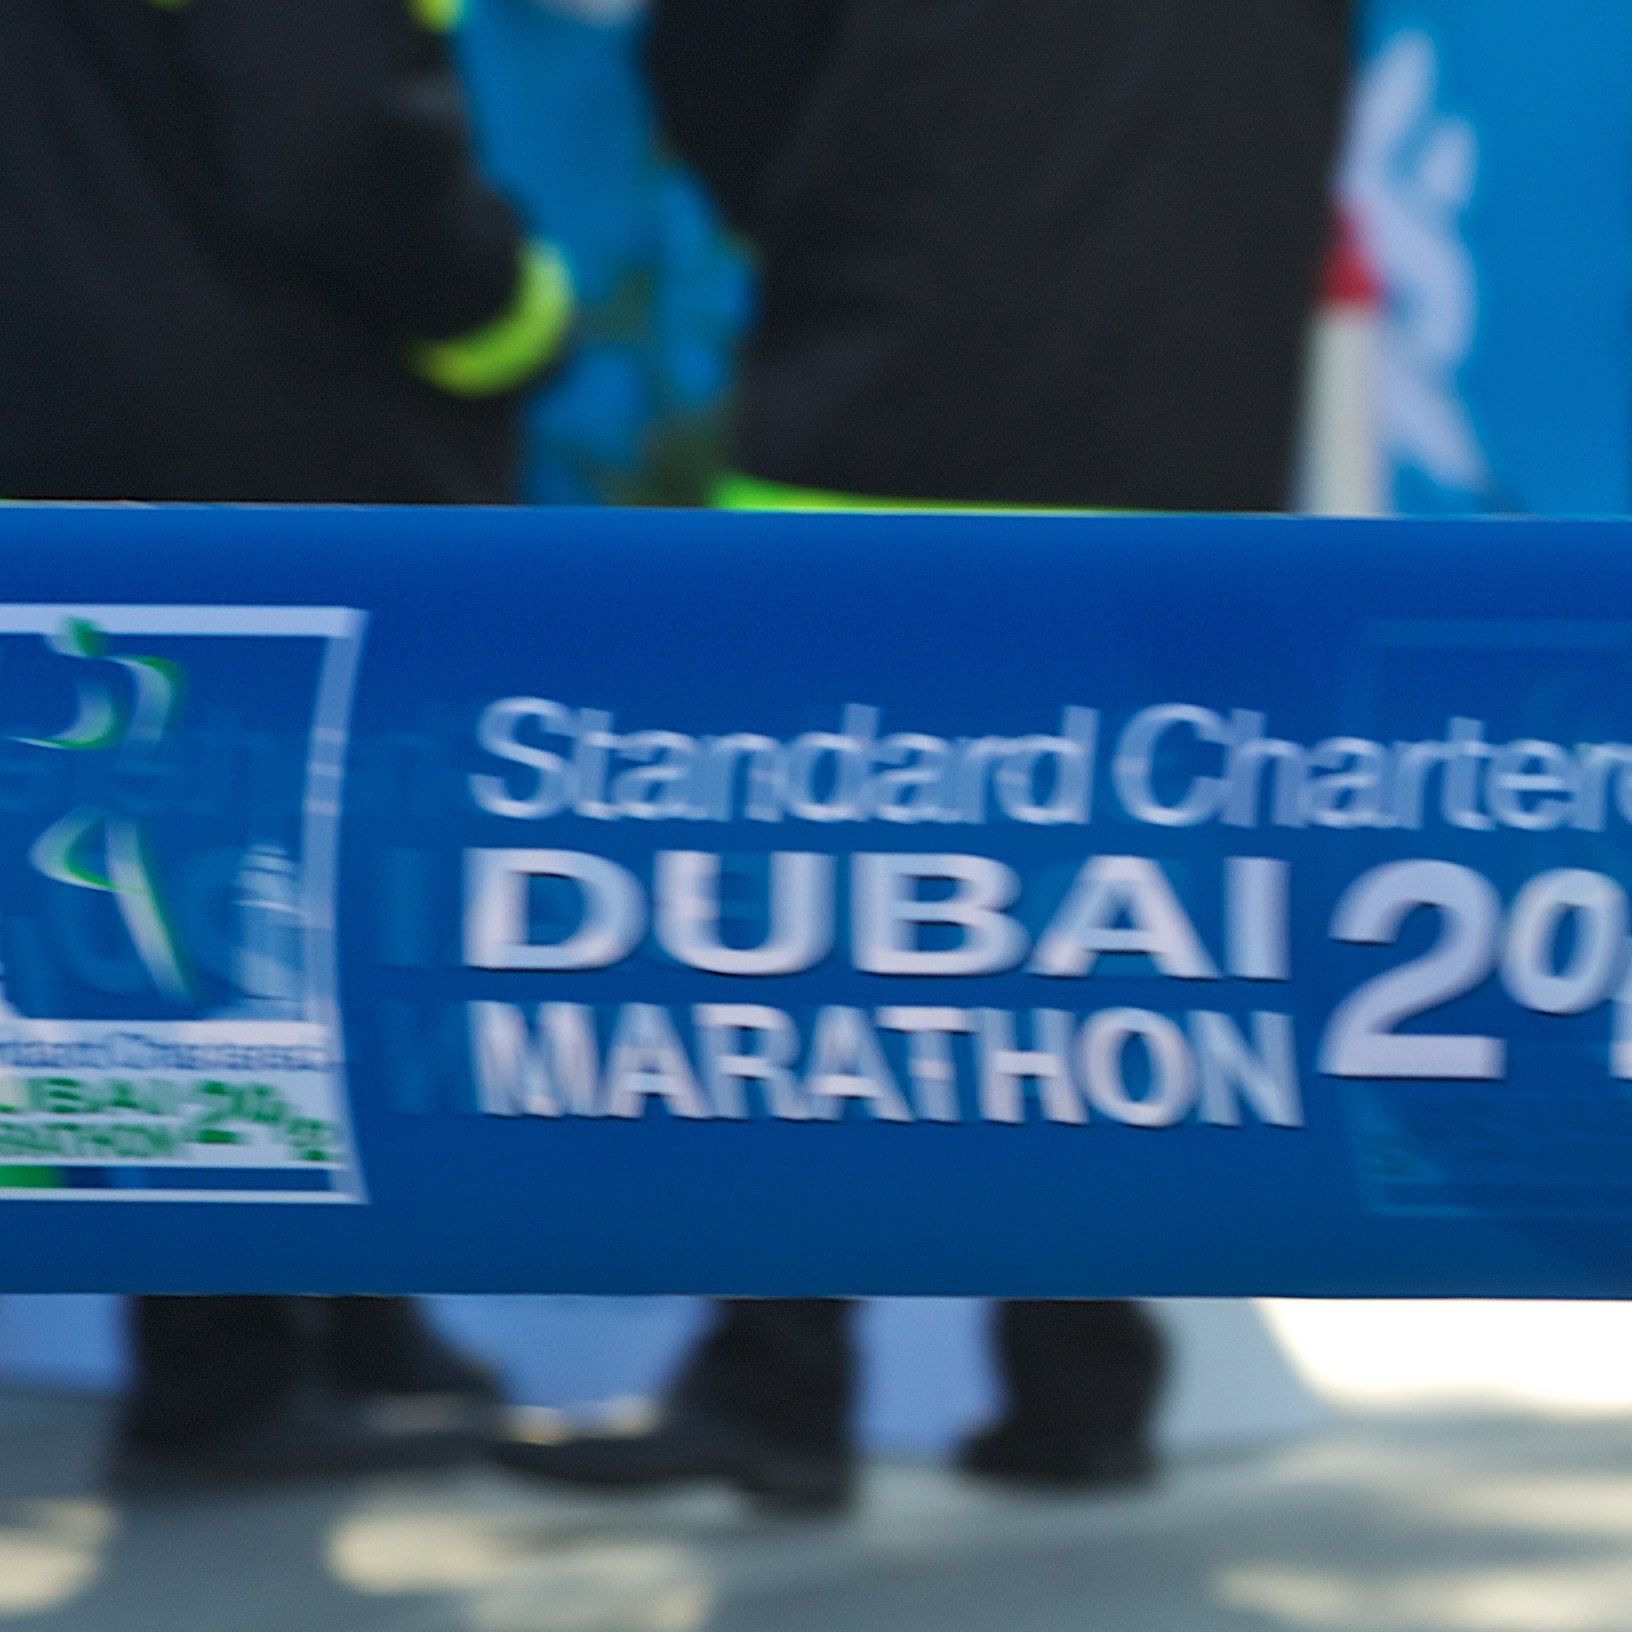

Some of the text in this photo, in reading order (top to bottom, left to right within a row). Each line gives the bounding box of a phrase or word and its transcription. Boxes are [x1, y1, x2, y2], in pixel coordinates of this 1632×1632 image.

[470, 696, 1100, 825] Standard
[463, 847, 1292, 981] DUBAI
[467, 1001, 1306, 1128] MARATHON
